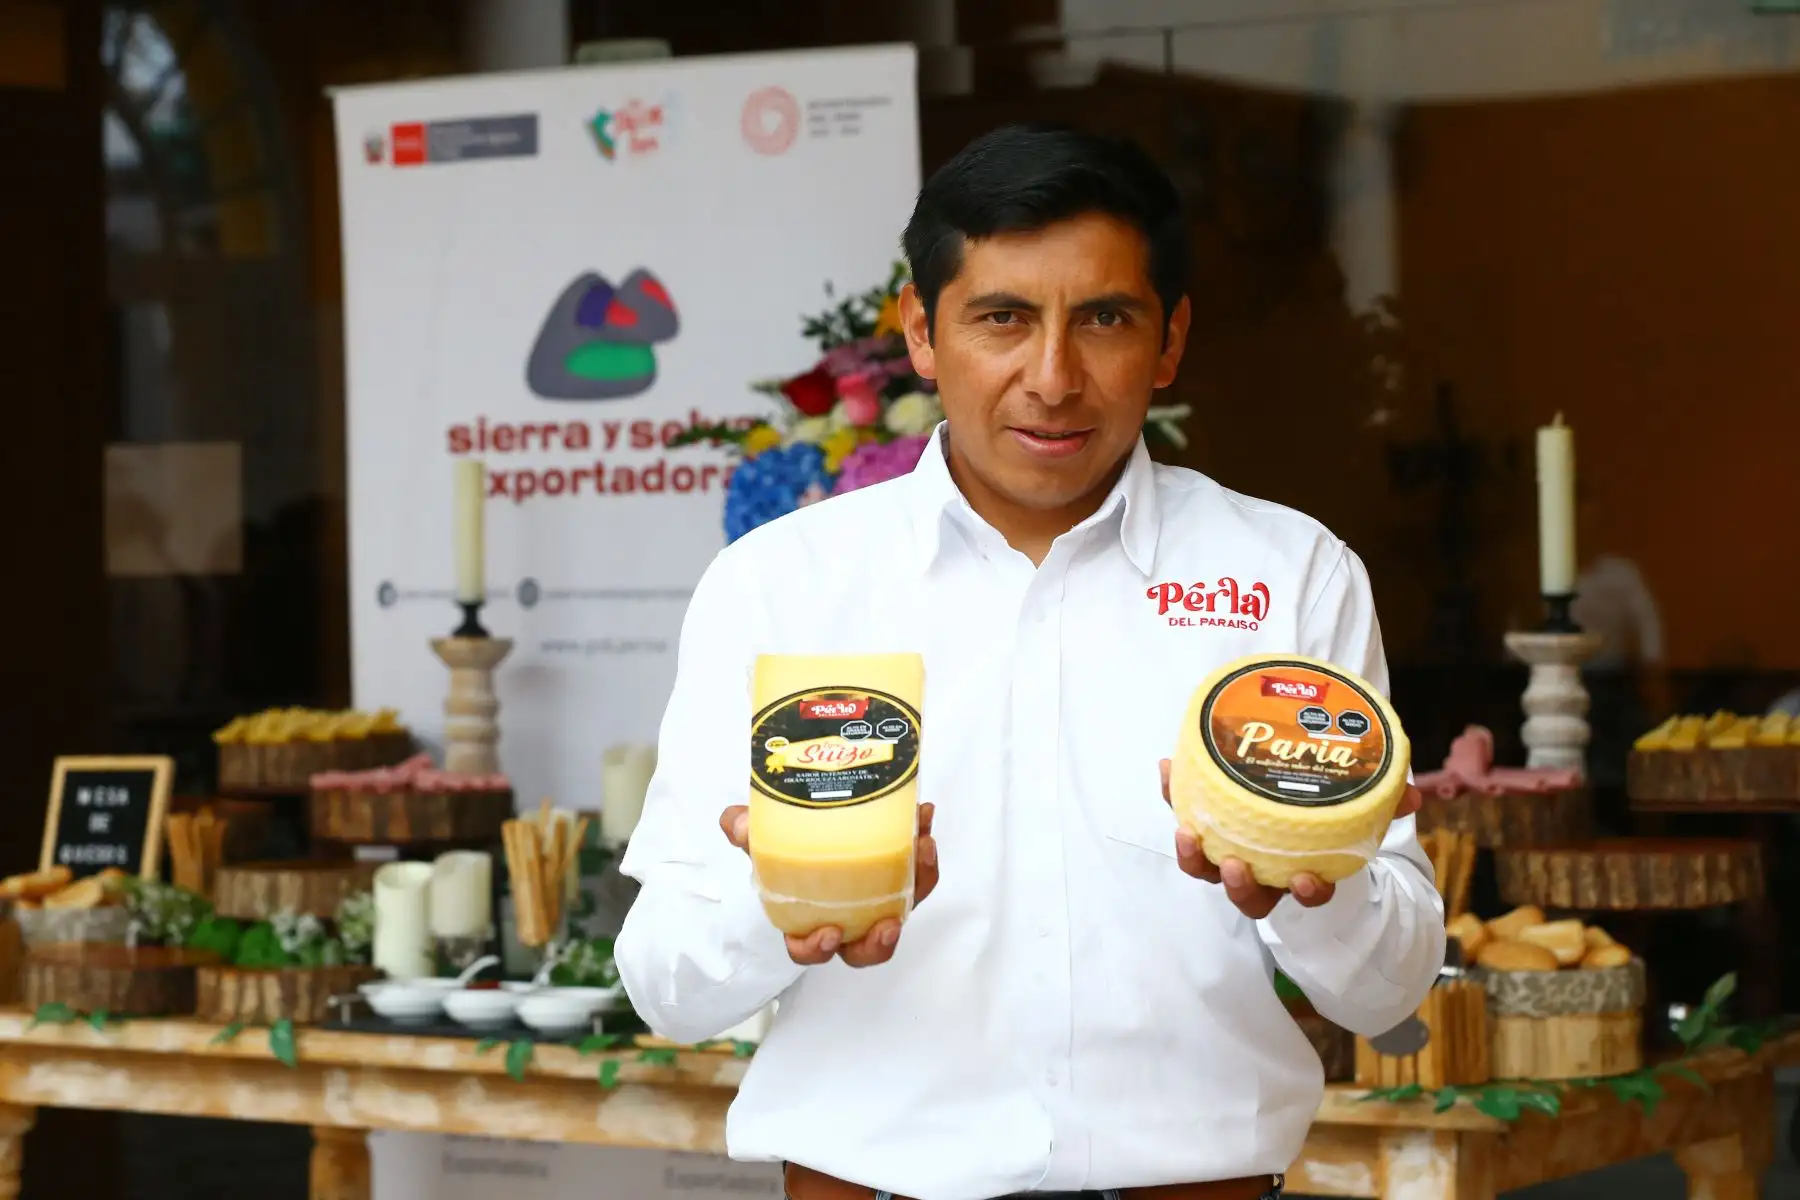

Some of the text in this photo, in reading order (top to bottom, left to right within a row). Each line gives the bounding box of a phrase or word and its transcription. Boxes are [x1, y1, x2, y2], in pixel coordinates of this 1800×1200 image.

[447, 415, 591, 453] sierra
[601, 420, 621, 450] y
[1168, 617, 1259, 631] DEL PARAISO
[797, 743, 874, 766] Suizo
[1236, 721, 1358, 768] Paria
